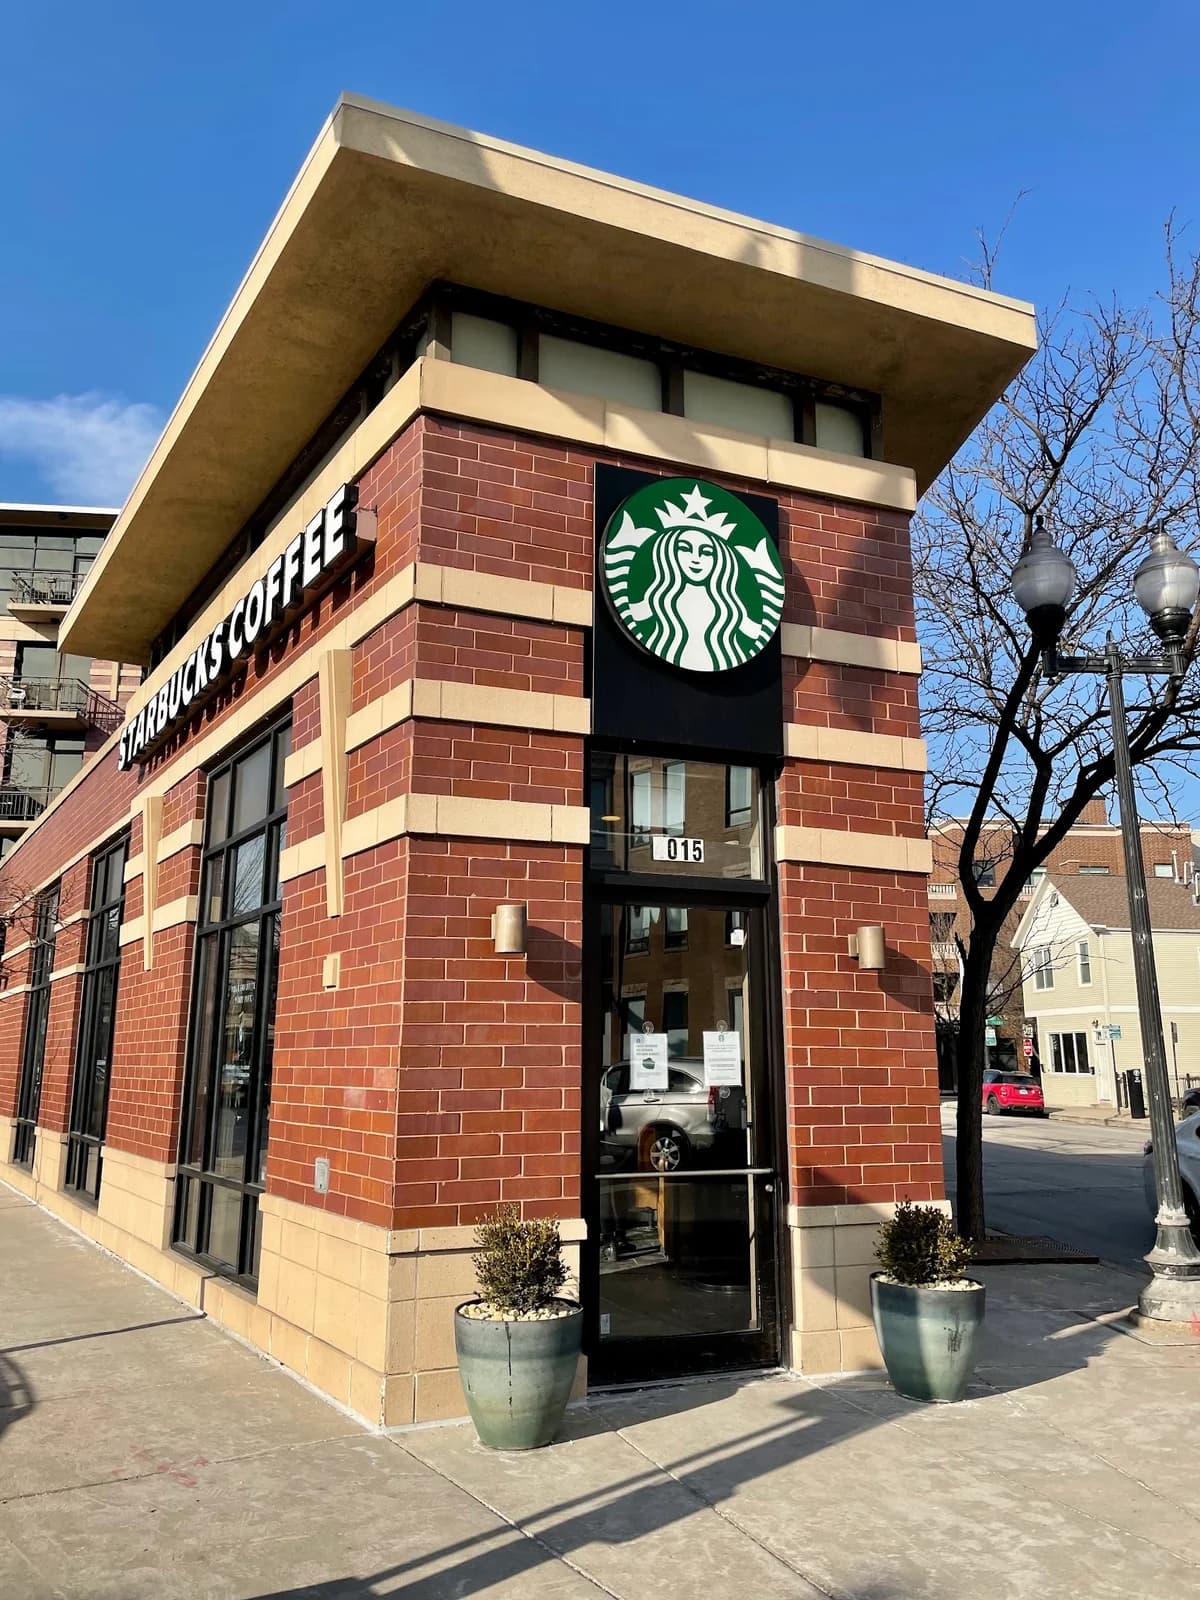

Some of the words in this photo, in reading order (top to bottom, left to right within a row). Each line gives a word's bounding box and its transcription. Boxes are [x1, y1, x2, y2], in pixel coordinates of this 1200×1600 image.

[118, 621, 224, 771] STARBUCKS
[228, 483, 348, 660] COFFEE
[667, 838, 702, 862] 015
